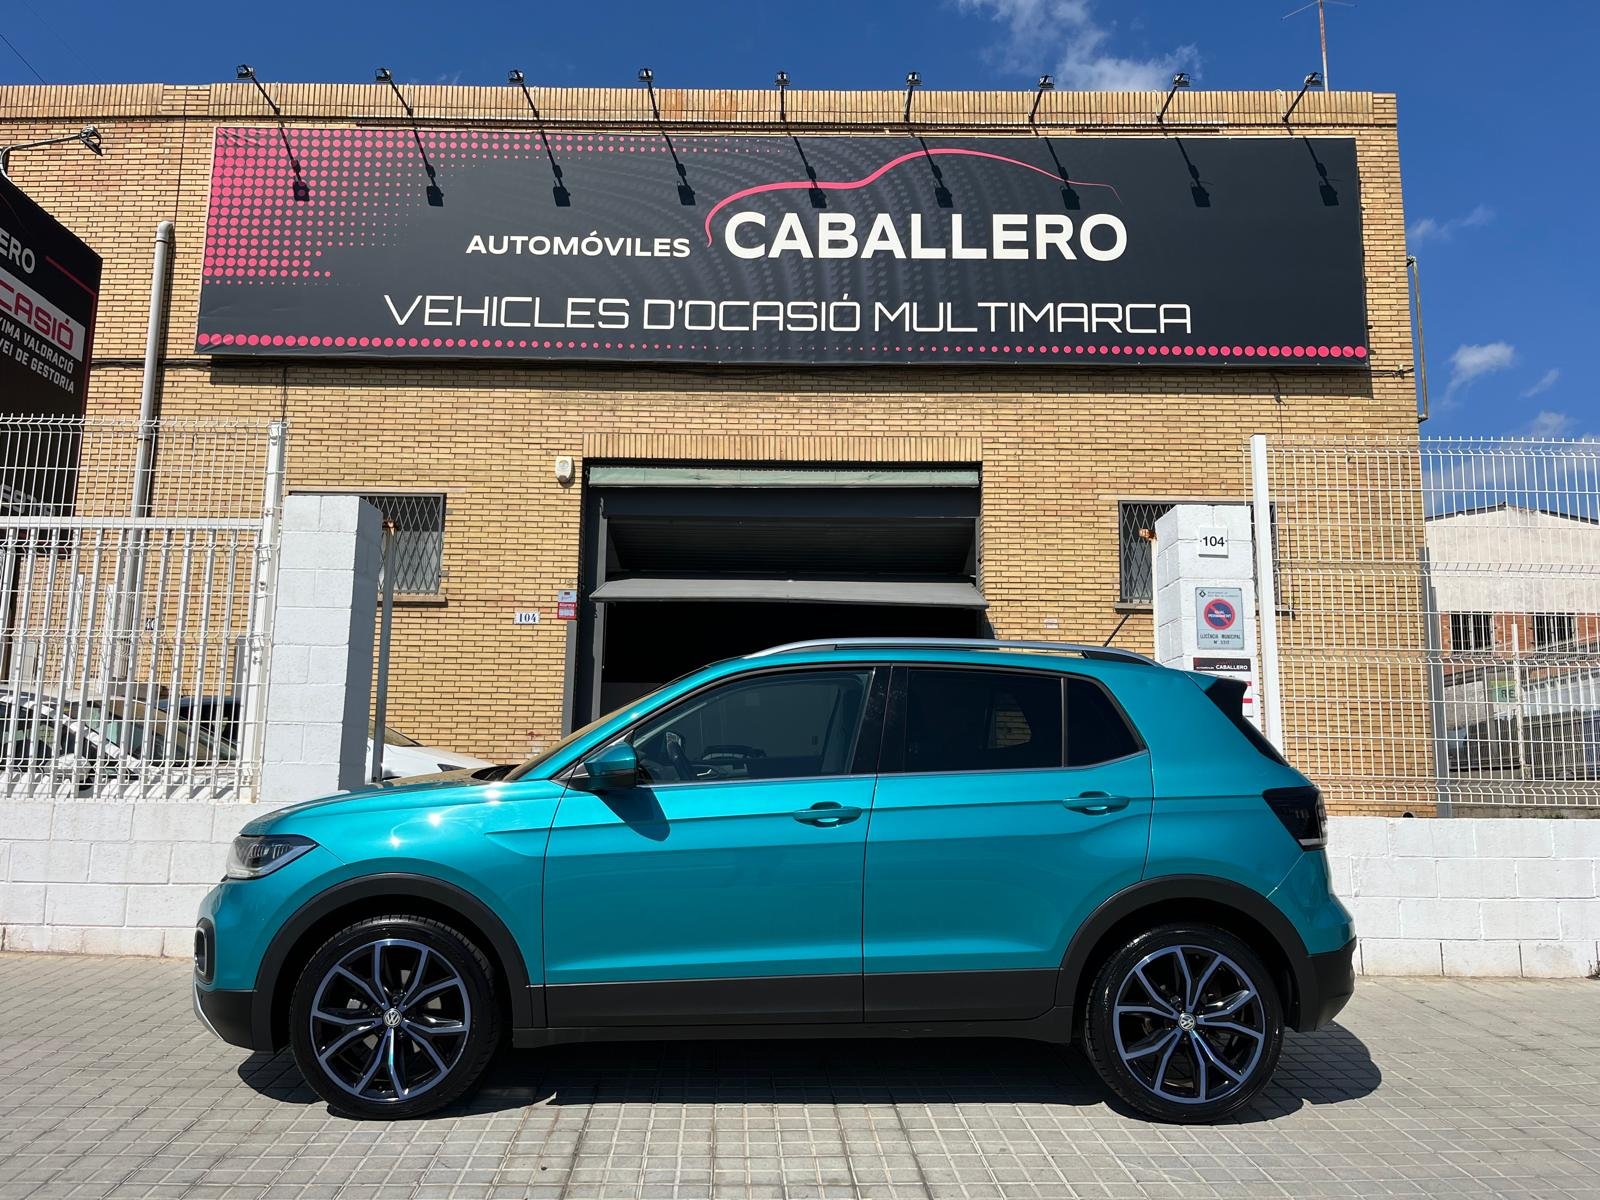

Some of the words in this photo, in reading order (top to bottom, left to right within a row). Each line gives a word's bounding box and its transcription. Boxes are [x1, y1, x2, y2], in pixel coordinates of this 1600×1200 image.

[465, 230, 691, 258] AUTOMÓVILES
[724, 210, 1128, 262] CABALLERO
[384, 294, 630, 329] VEHICLES
[874, 302, 1192, 334] MULTIMARCA
[15, 347, 30, 366] DE
[30, 357, 75, 394] GESTORIA
[23, 332, 74, 375] VALORACIÓ
[1202, 535, 1225, 547] 104
[519, 613, 537, 623] 104
